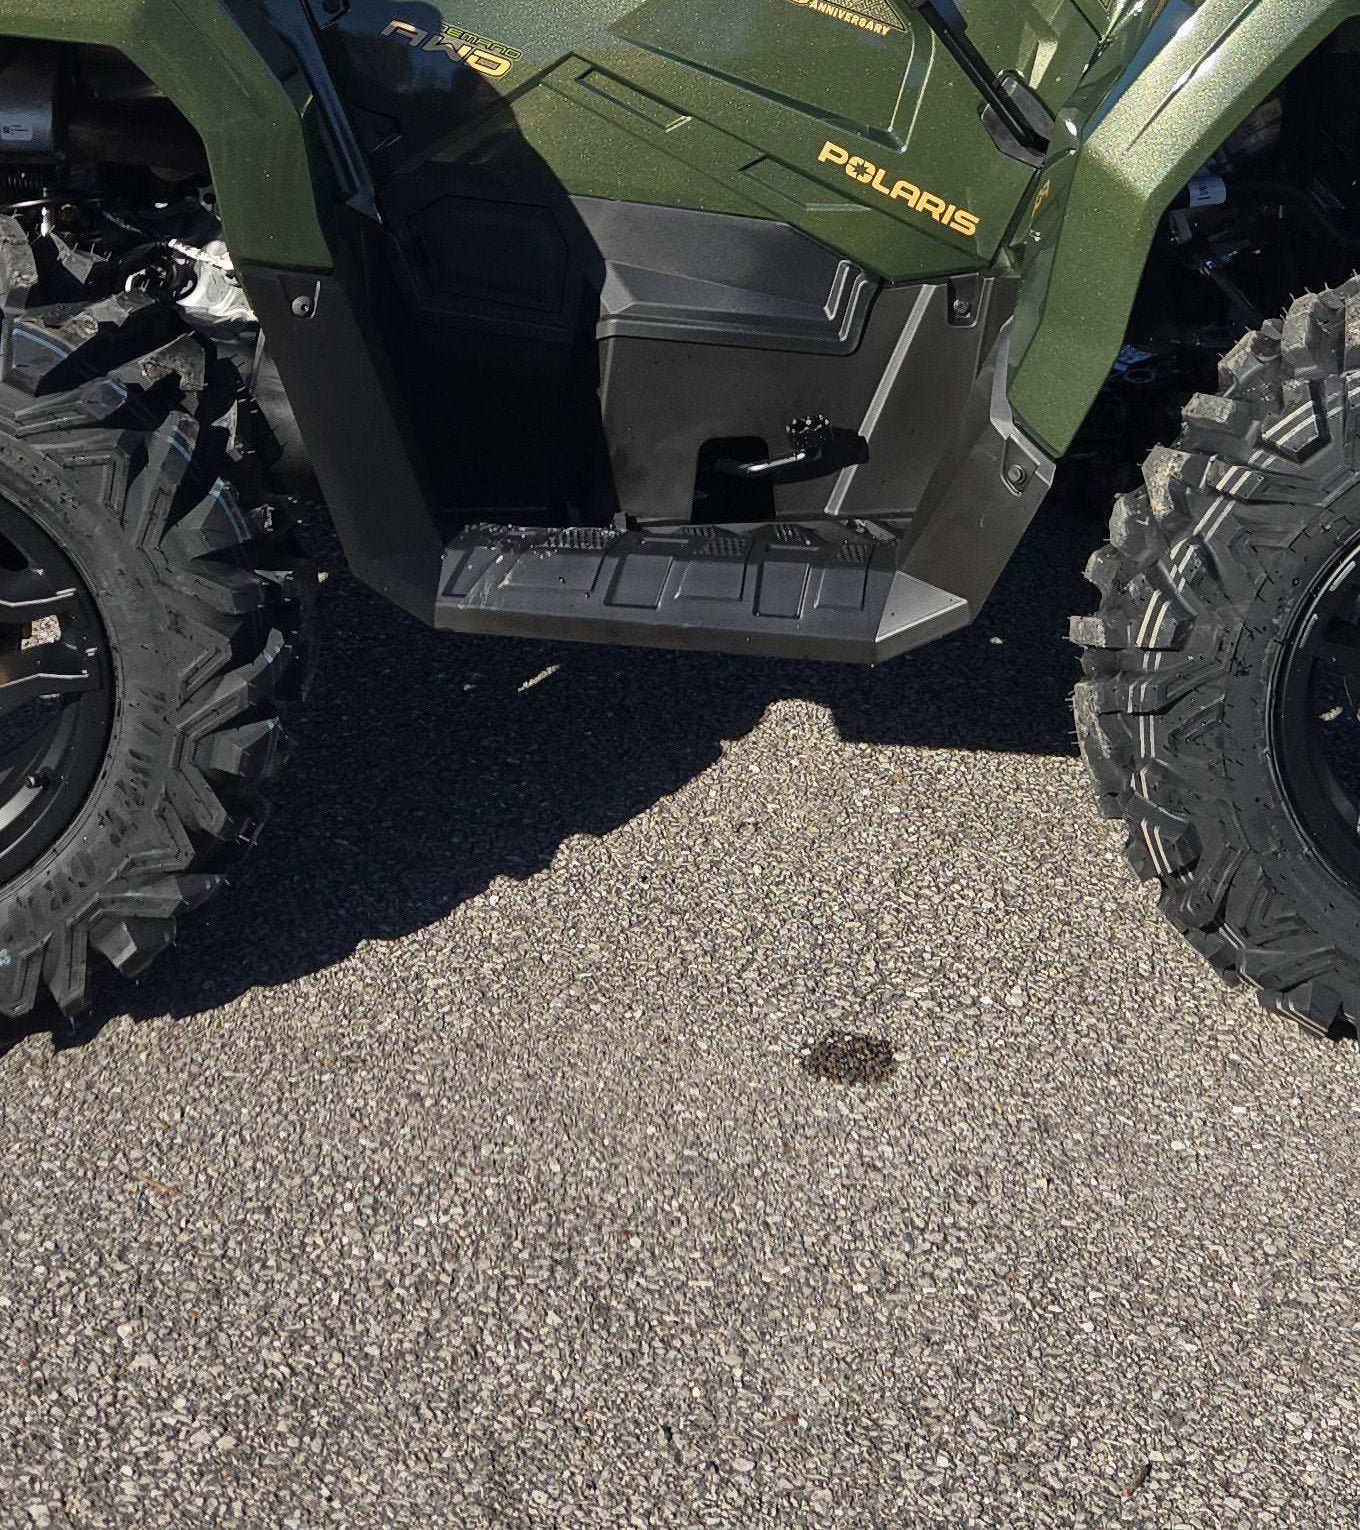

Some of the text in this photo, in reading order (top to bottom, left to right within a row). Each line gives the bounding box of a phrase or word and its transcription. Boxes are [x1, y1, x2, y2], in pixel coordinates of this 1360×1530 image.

[809, 0, 891, 36] ANNIVERSARY
[380, 19, 513, 78] AWD
[818, 140, 981, 237] POLARIS
